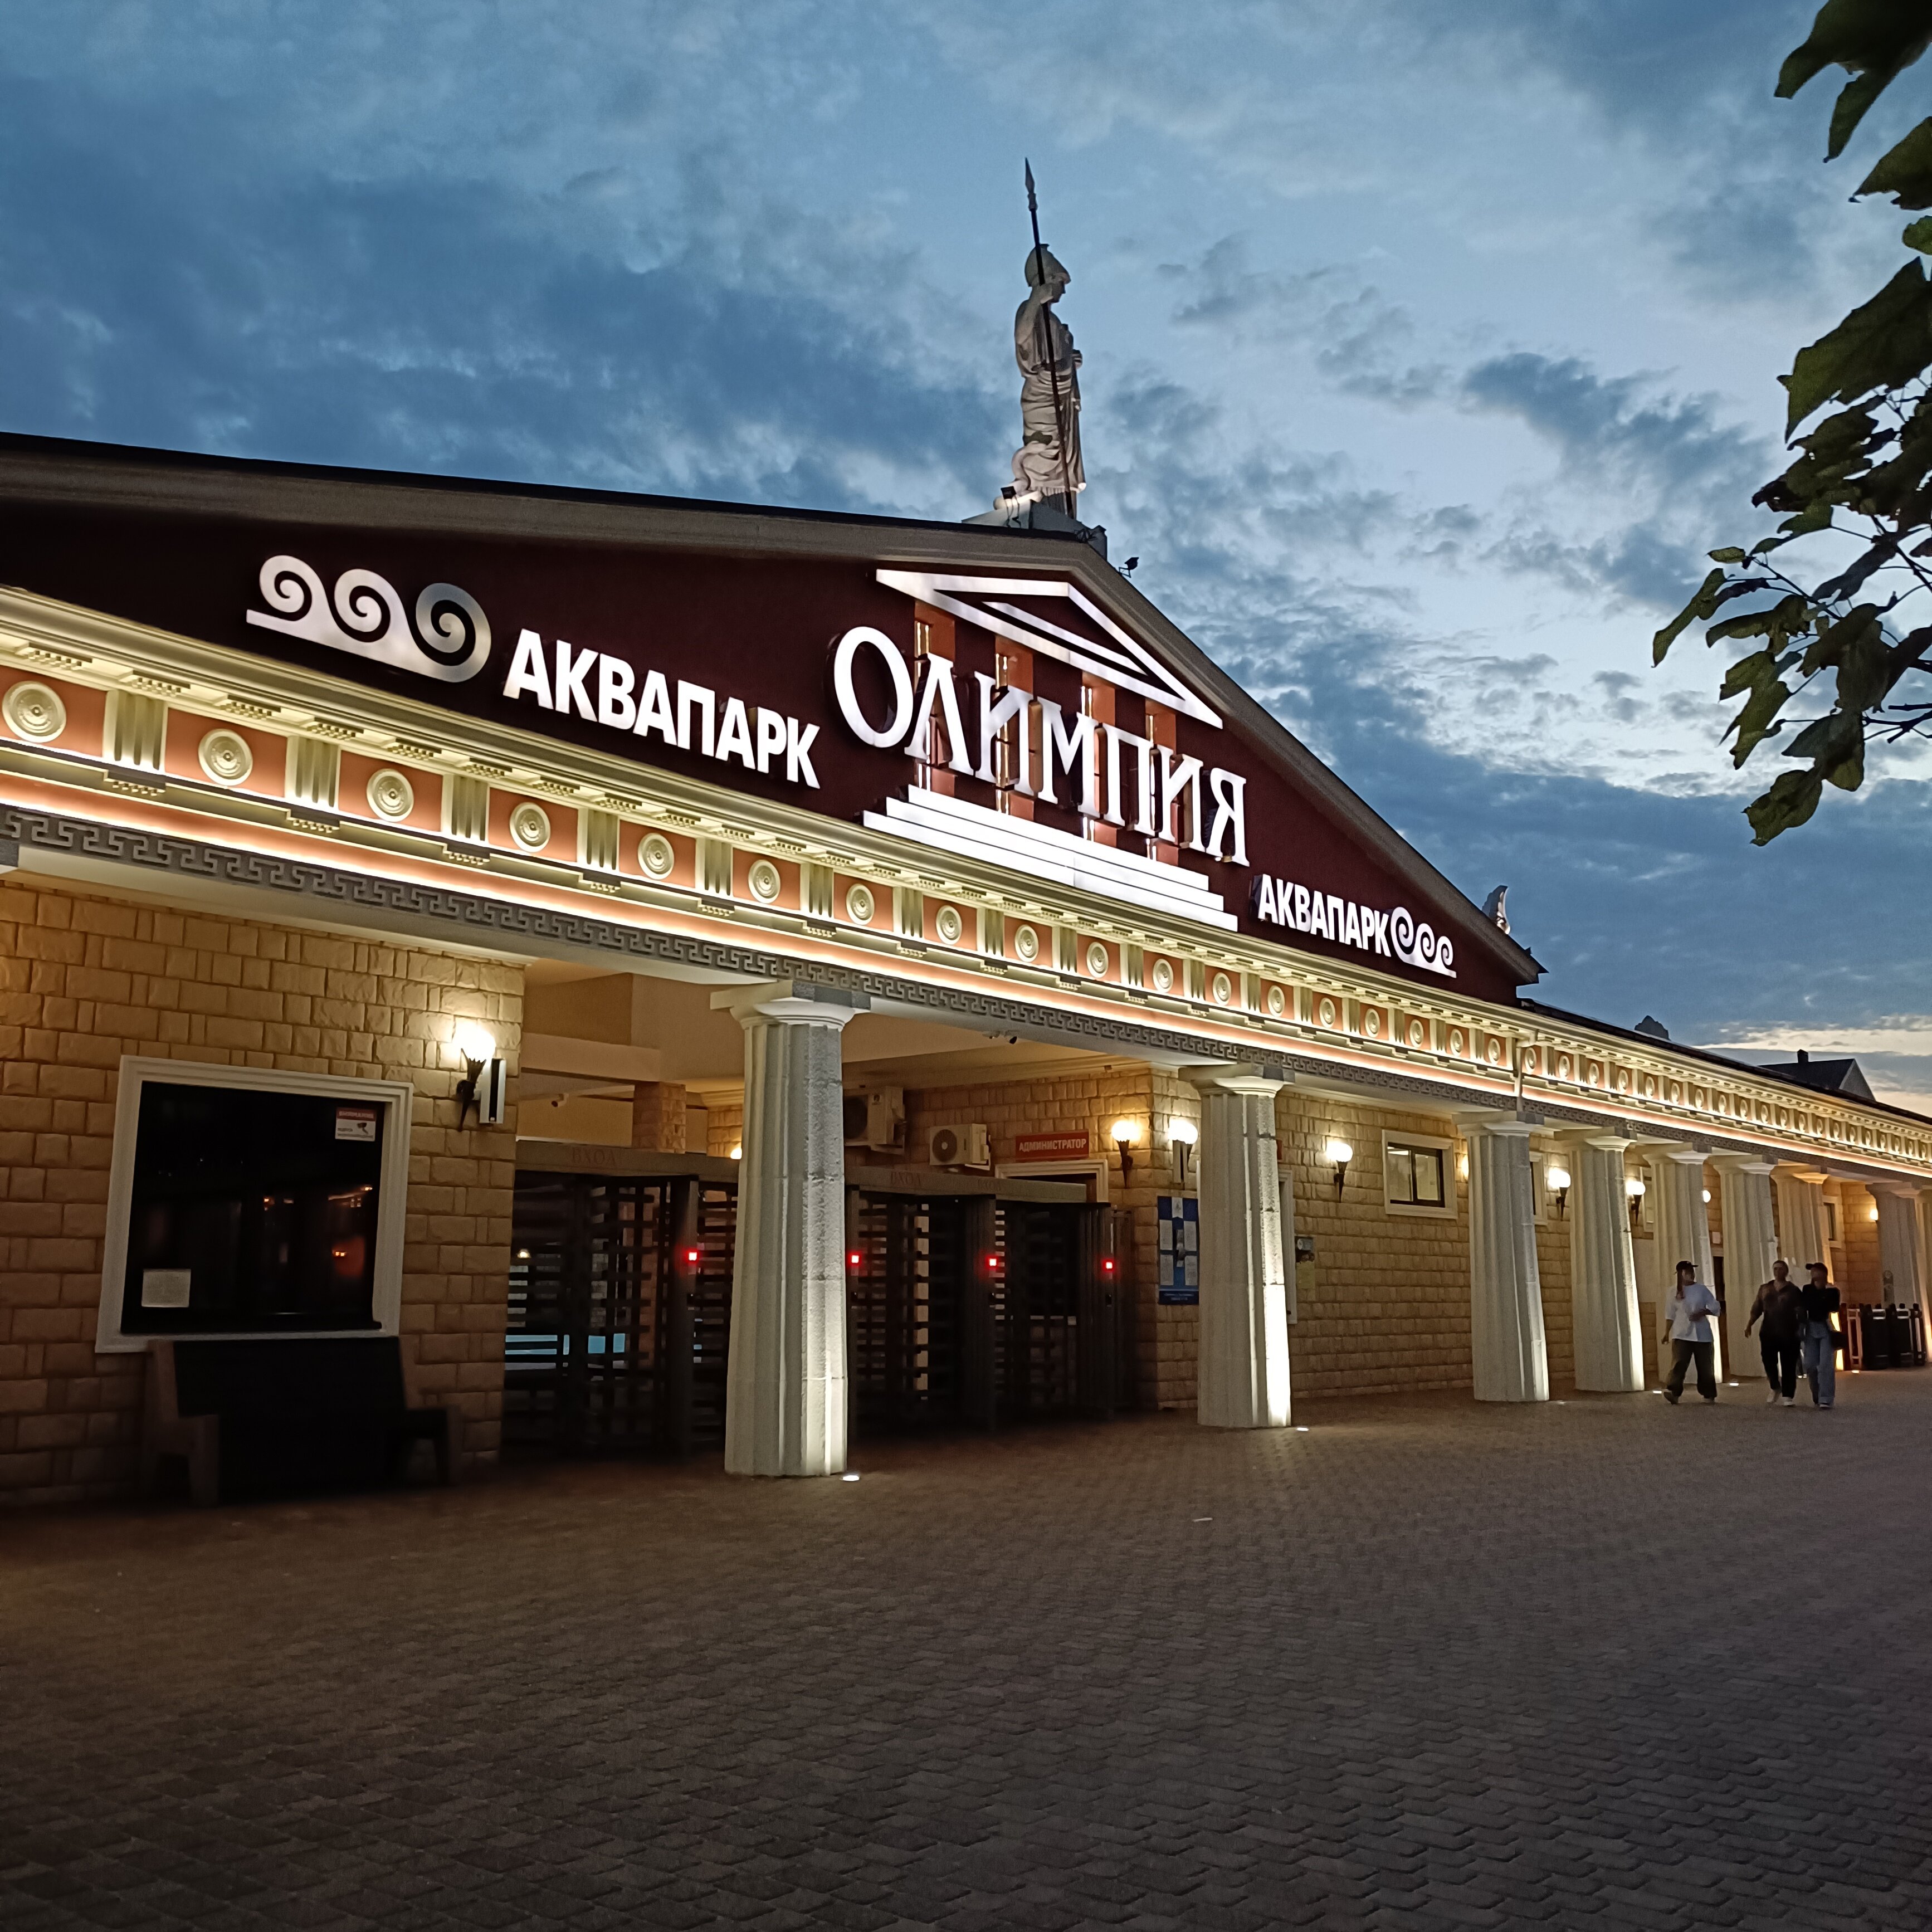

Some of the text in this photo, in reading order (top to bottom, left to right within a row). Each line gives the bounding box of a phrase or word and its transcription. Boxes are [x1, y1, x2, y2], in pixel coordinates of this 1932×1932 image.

[503, 629, 819, 789] АКВАПАРК
[833, 626, 1250, 867] ОЛИМПИЯ
[1258, 874, 1391, 957] АКВАПАРК
[1019, 1139, 1086, 1152] АДМИНИСТРАТОР
